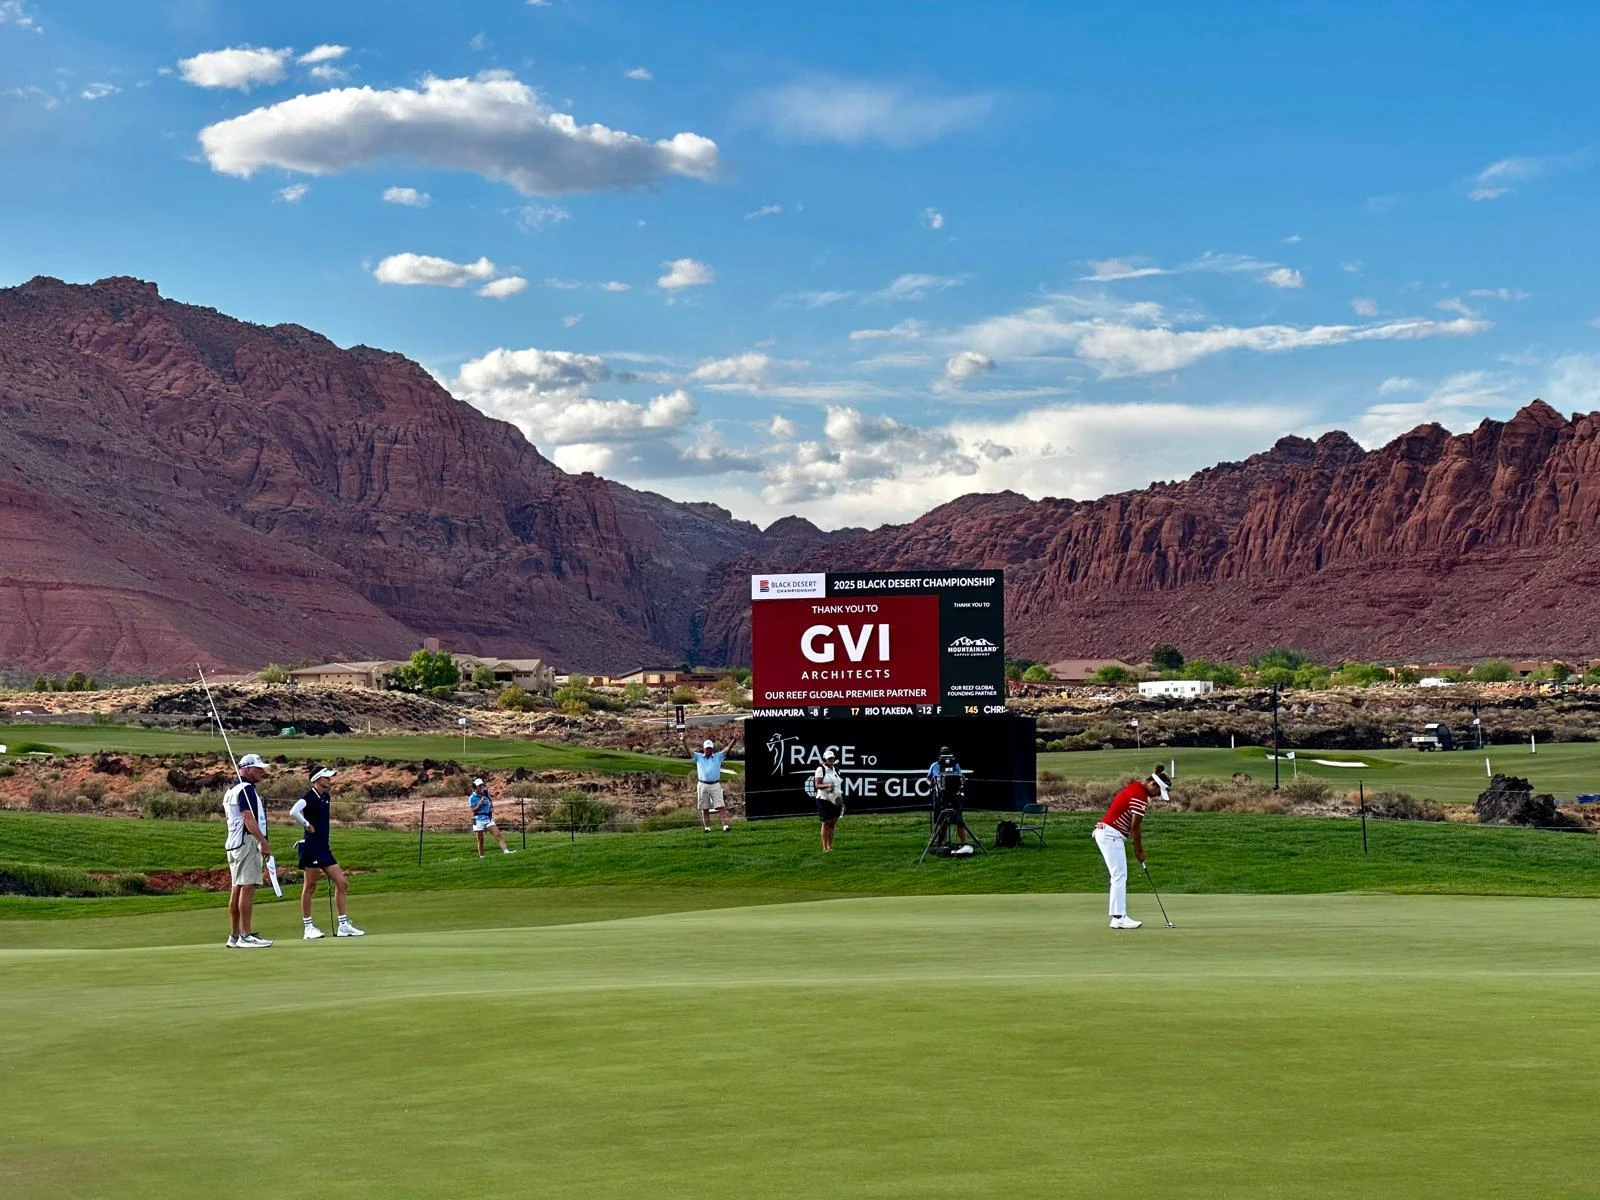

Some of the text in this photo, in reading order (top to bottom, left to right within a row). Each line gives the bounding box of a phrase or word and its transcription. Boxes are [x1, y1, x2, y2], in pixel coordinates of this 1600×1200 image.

[834, 577, 995, 590] 2025 BLACK DESERT CHAMPIONSHIP
[812, 604, 879, 614] THANK YOU TO
[800, 623, 890, 664] GVI
[801, 669, 890, 680] ARCHITECTS
[765, 688, 927, 700] OUR REEF GLOBAL PREMIER PARTNER
[752, 708, 805, 717] WANNAPURA
[809, 708, 819, 717] -8
[823, 708, 829, 716] F
[850, 707, 860, 716] 17
[864, 707, 880, 716] RIO
[881, 706, 913, 715] TAKEDA
[918, 706, 932, 715] -12
[936, 706, 942, 714] F
[964, 705, 979, 714] T45
[861, 755, 877, 766] TO
[884, 777, 932, 797] GLO
